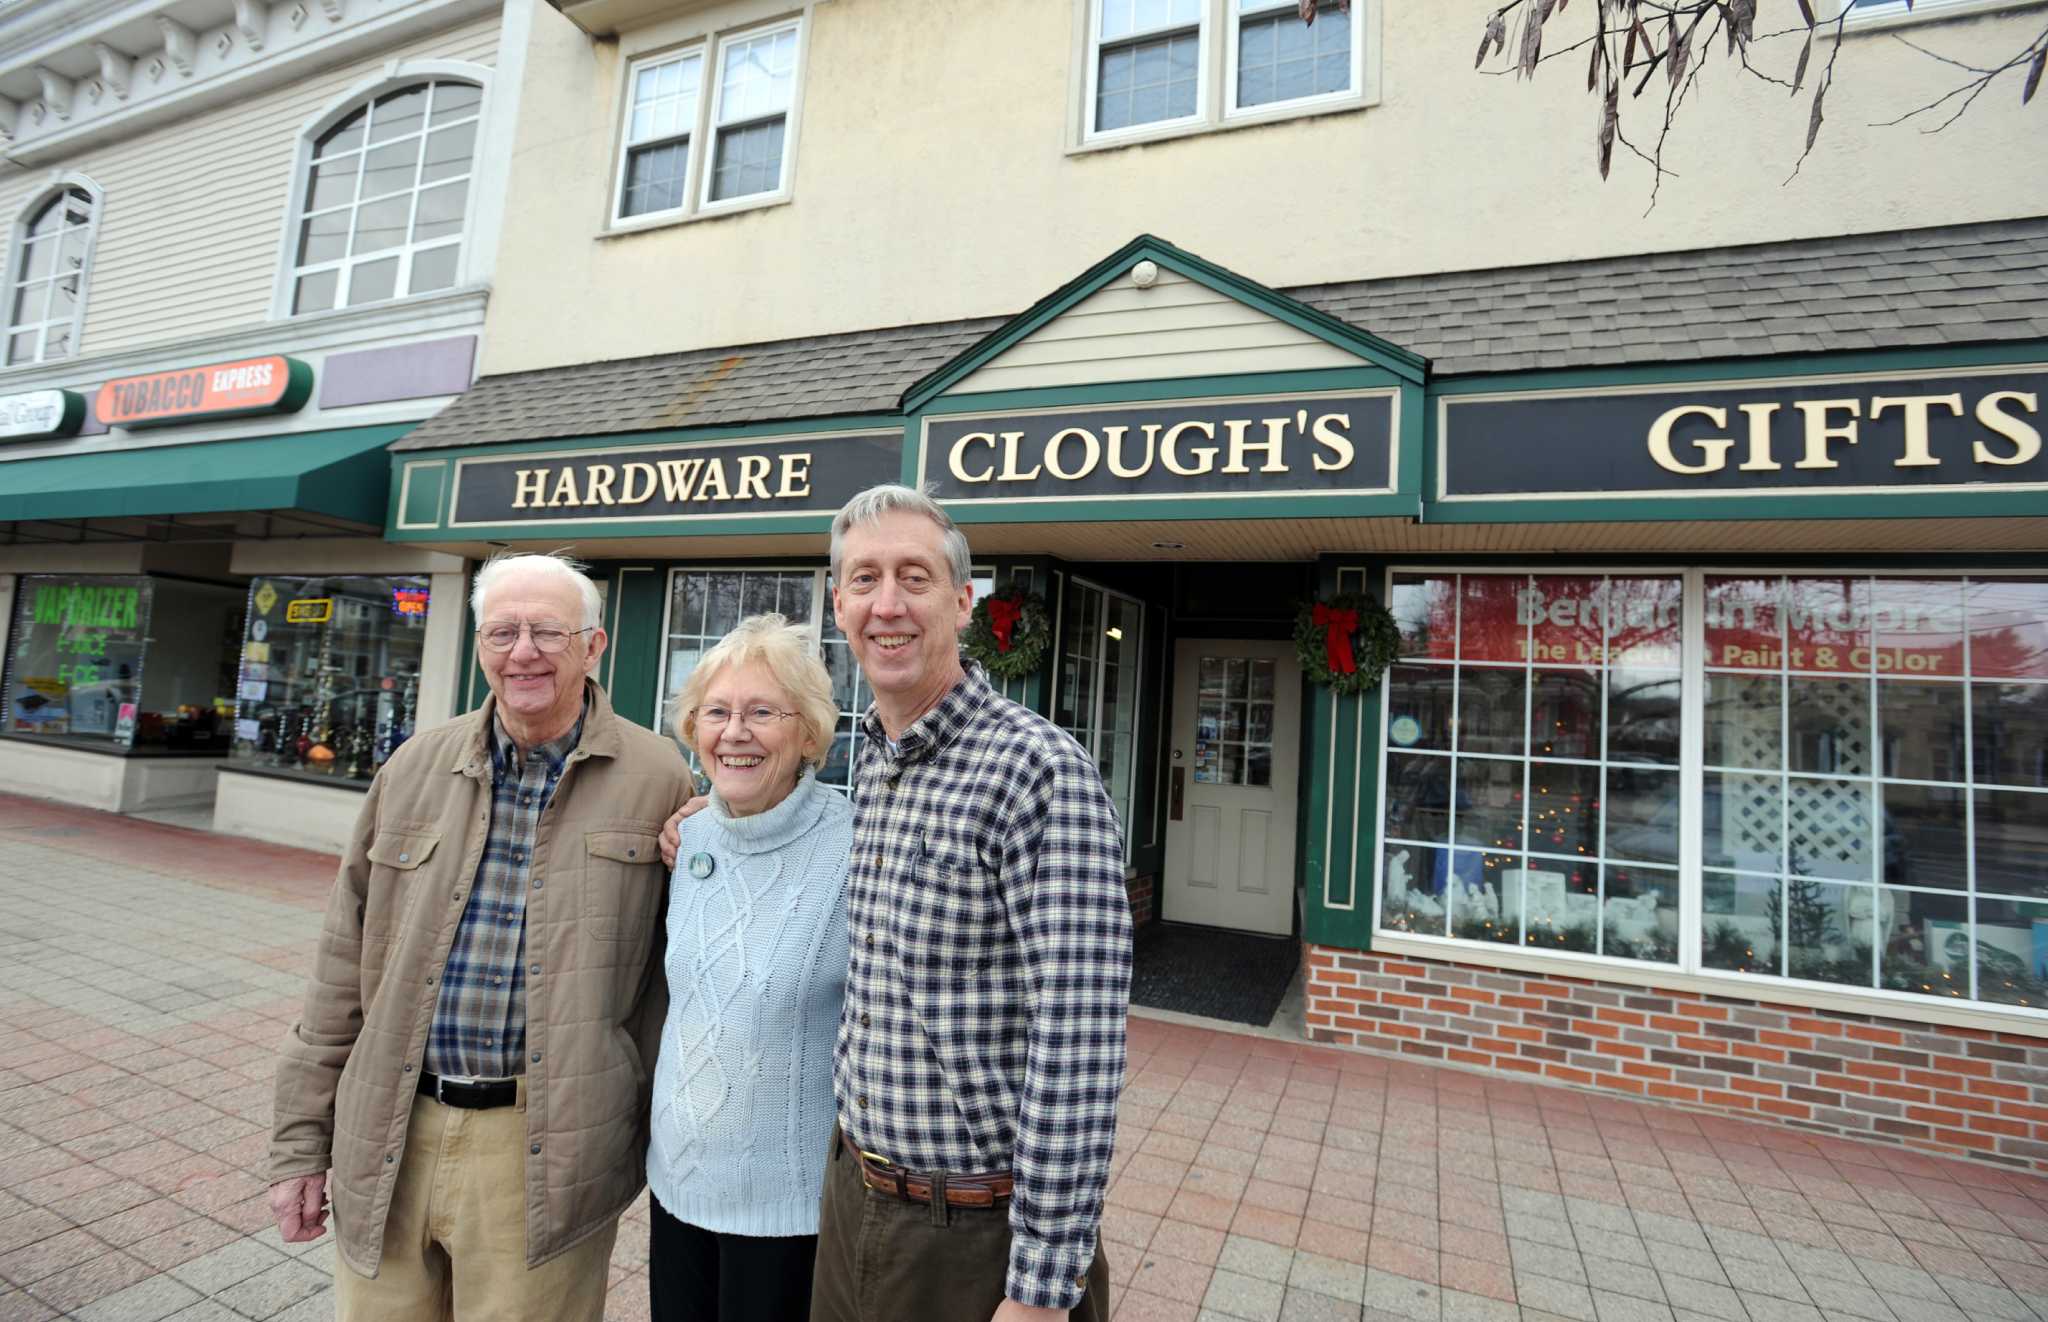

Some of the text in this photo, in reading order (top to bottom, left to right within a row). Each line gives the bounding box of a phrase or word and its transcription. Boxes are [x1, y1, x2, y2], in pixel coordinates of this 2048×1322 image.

[112, 364, 273, 417] TOBACCO EXPRESS
[948, 409, 1355, 483] CLOUGH'S
[1647, 390, 2043, 475] GIFTS
[511, 452, 812, 508] HARDWARE
[33, 584, 140, 629] VAPORIZER
[1517, 639, 1567, 660] The
[1722, 644, 1804, 668] Paint
[1815, 647, 1839, 669] &
[1850, 647, 1943, 672] Color
